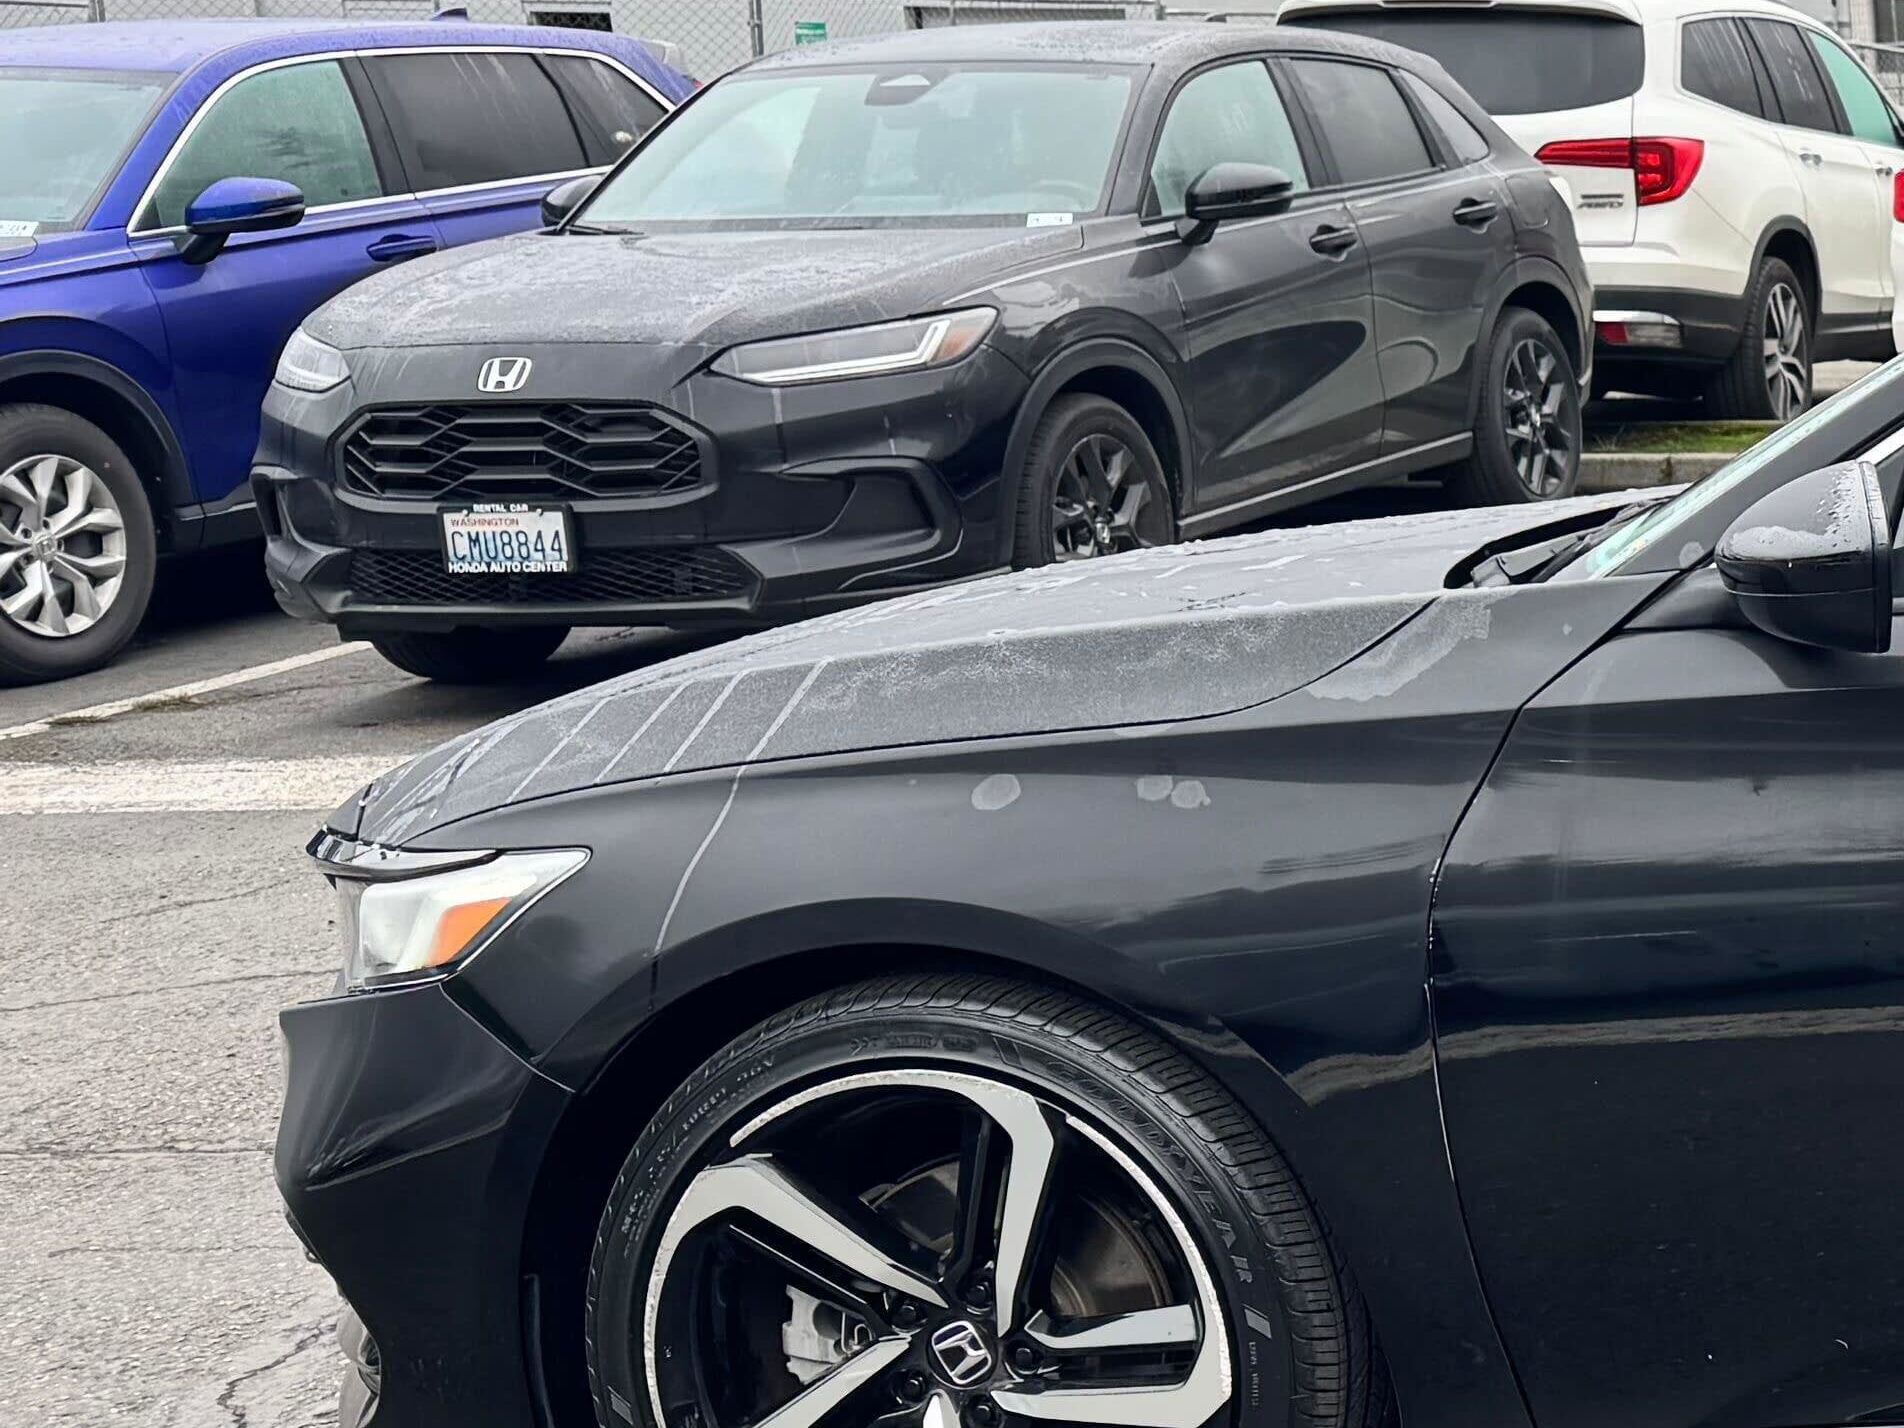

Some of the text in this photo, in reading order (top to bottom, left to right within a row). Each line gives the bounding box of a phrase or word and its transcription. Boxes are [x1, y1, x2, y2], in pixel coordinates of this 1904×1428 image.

[472, 503, 529, 513] RENTAL CAR
[450, 517, 520, 527] WASHINGTON
[451, 529, 563, 561] CMU8844
[448, 561, 568, 573] HONDA AUTO CENTER
[1046, 1060, 1256, 1285] GOODYEAR
